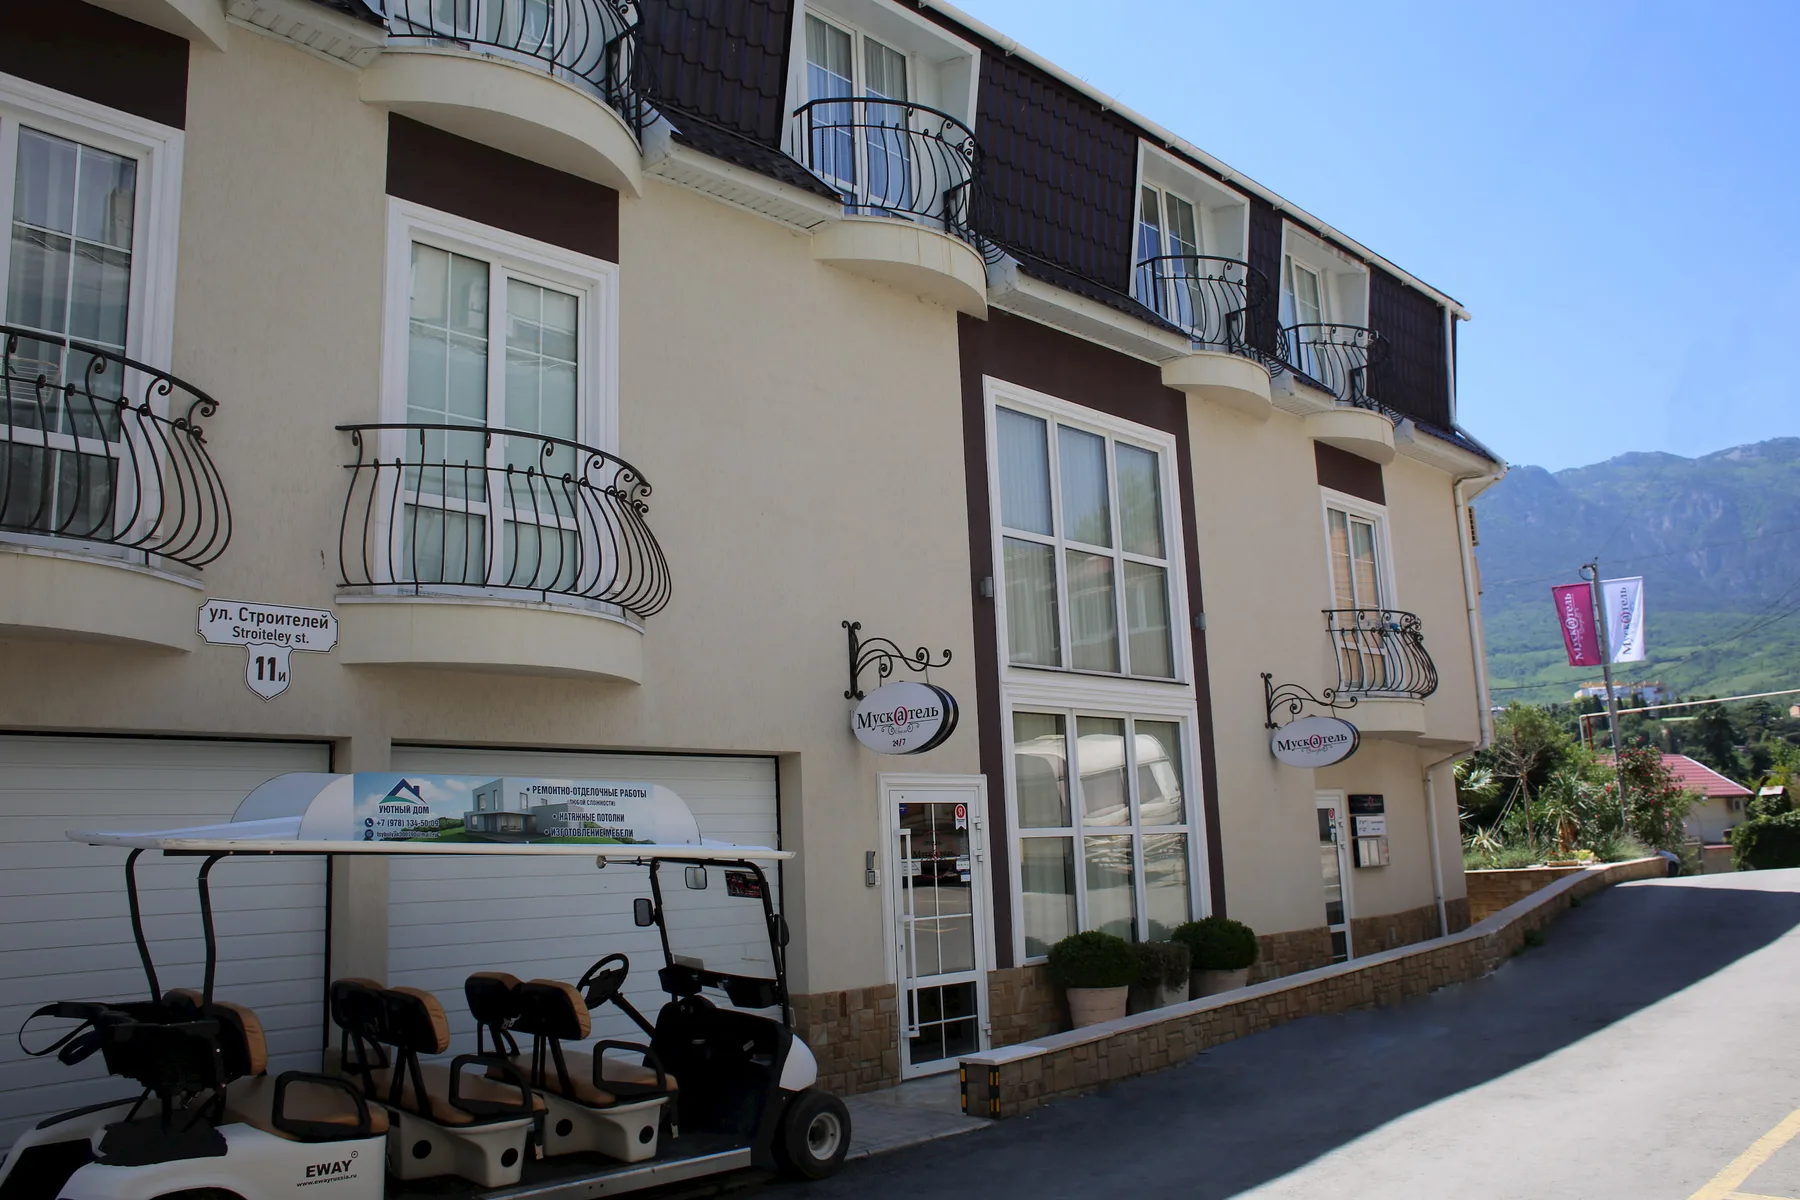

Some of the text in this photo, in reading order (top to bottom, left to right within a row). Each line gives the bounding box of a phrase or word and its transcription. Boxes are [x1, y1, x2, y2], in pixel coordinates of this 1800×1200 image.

[209, 606, 329, 629] ул. Строителей
[232, 625, 309, 645] Stroiteley st.
[892, 738, 906, 748] 24/7
[532, 785, 647, 798] РЕМОНТНО-ОТДЕЛОЧНЫЕ РАБОТЫ
[378, 804, 430, 815] УЮТНЫЙ ДОМ
[376, 819, 386, 827] +7
[387, 818, 405, 827] (978)
[559, 812, 625, 822] НАТЯЖНЫЕ ПОТОЛКИ
[550, 827, 634, 838] ИЗГОТОВЛЕНИЕ МЕБЕЛИ
[306, 1160, 353, 1178] EWAY
[296, 1173, 357, 1187] www.ewayrussia.ru
